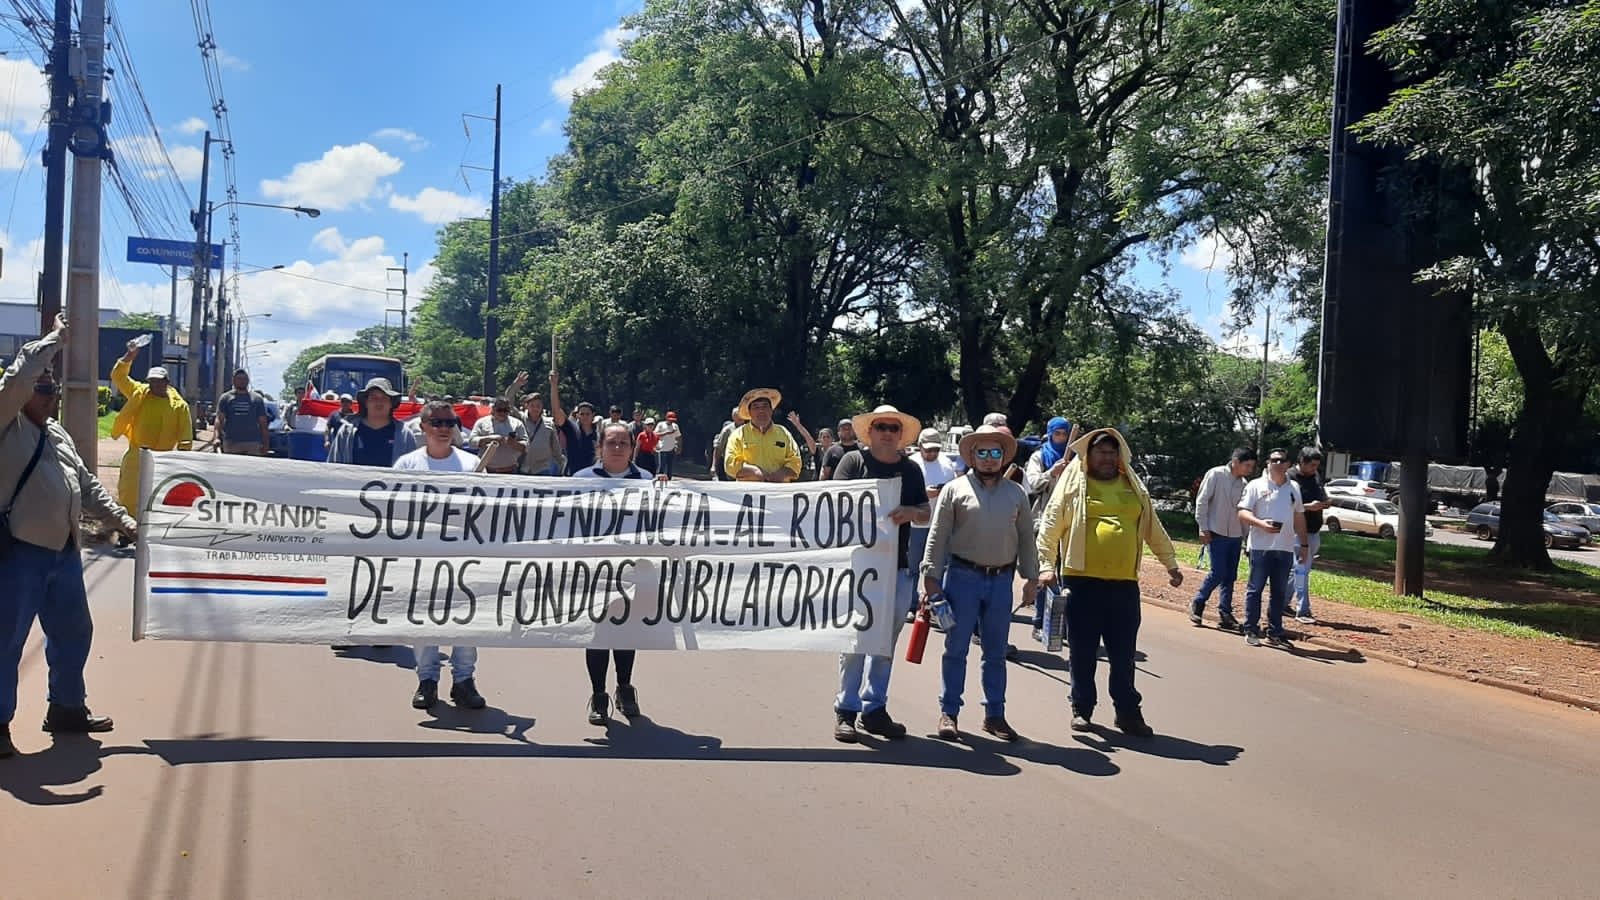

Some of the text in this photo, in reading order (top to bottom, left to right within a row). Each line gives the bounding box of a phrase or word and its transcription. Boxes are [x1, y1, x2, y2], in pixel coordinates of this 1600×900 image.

[197, 500, 329, 530] SITRANDE
[790, 490, 877, 549] ROBO
[256, 533, 326, 545] SINDICATO DE
[206, 550, 280, 561] TRABAJADORES
[347, 556, 878, 632] DE LOS FONDOS JUBILATORIOS
